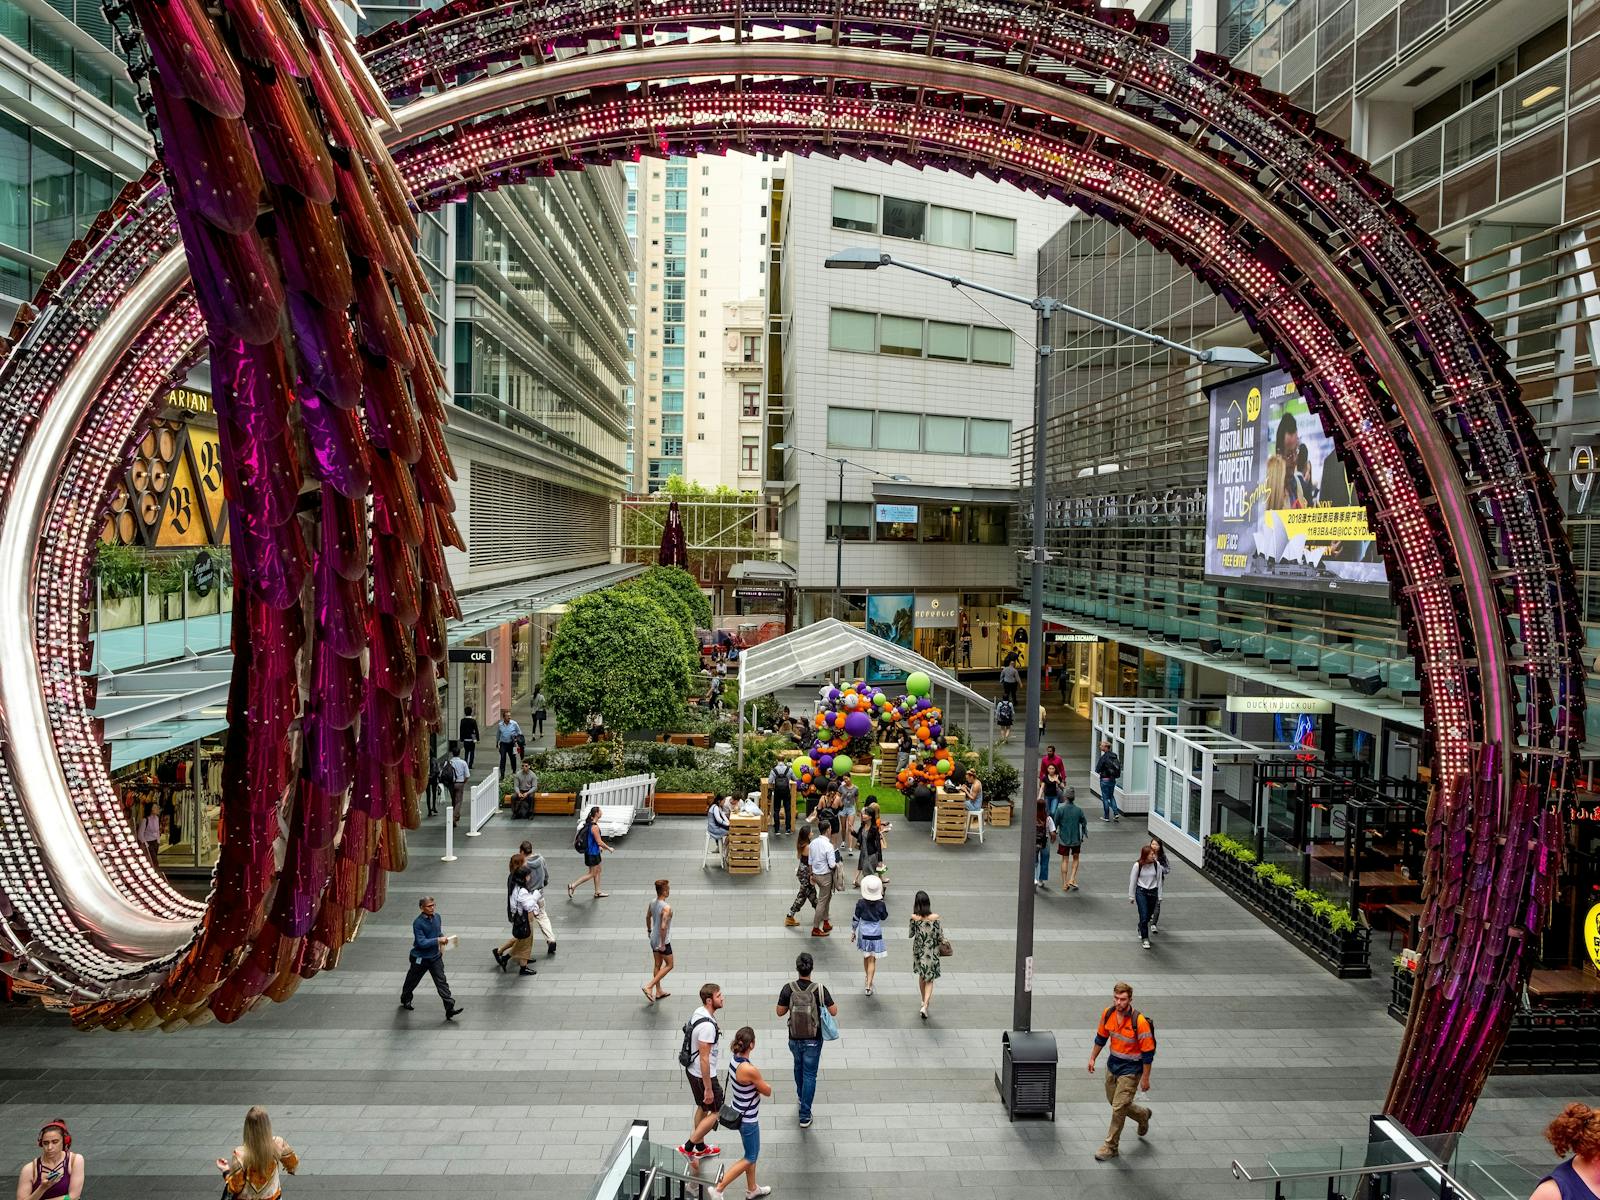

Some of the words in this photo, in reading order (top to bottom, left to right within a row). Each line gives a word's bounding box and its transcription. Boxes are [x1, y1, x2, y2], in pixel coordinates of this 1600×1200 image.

[1248, 395, 1260, 413] SYD
[1219, 426, 1255, 453] AUSTRALIAN
[1218, 456, 1254, 484] PROPERTY
[1223, 485, 1246, 517] EXPO
[470, 652, 486, 661] CUE
[1302, 702, 1316, 710] OUT
